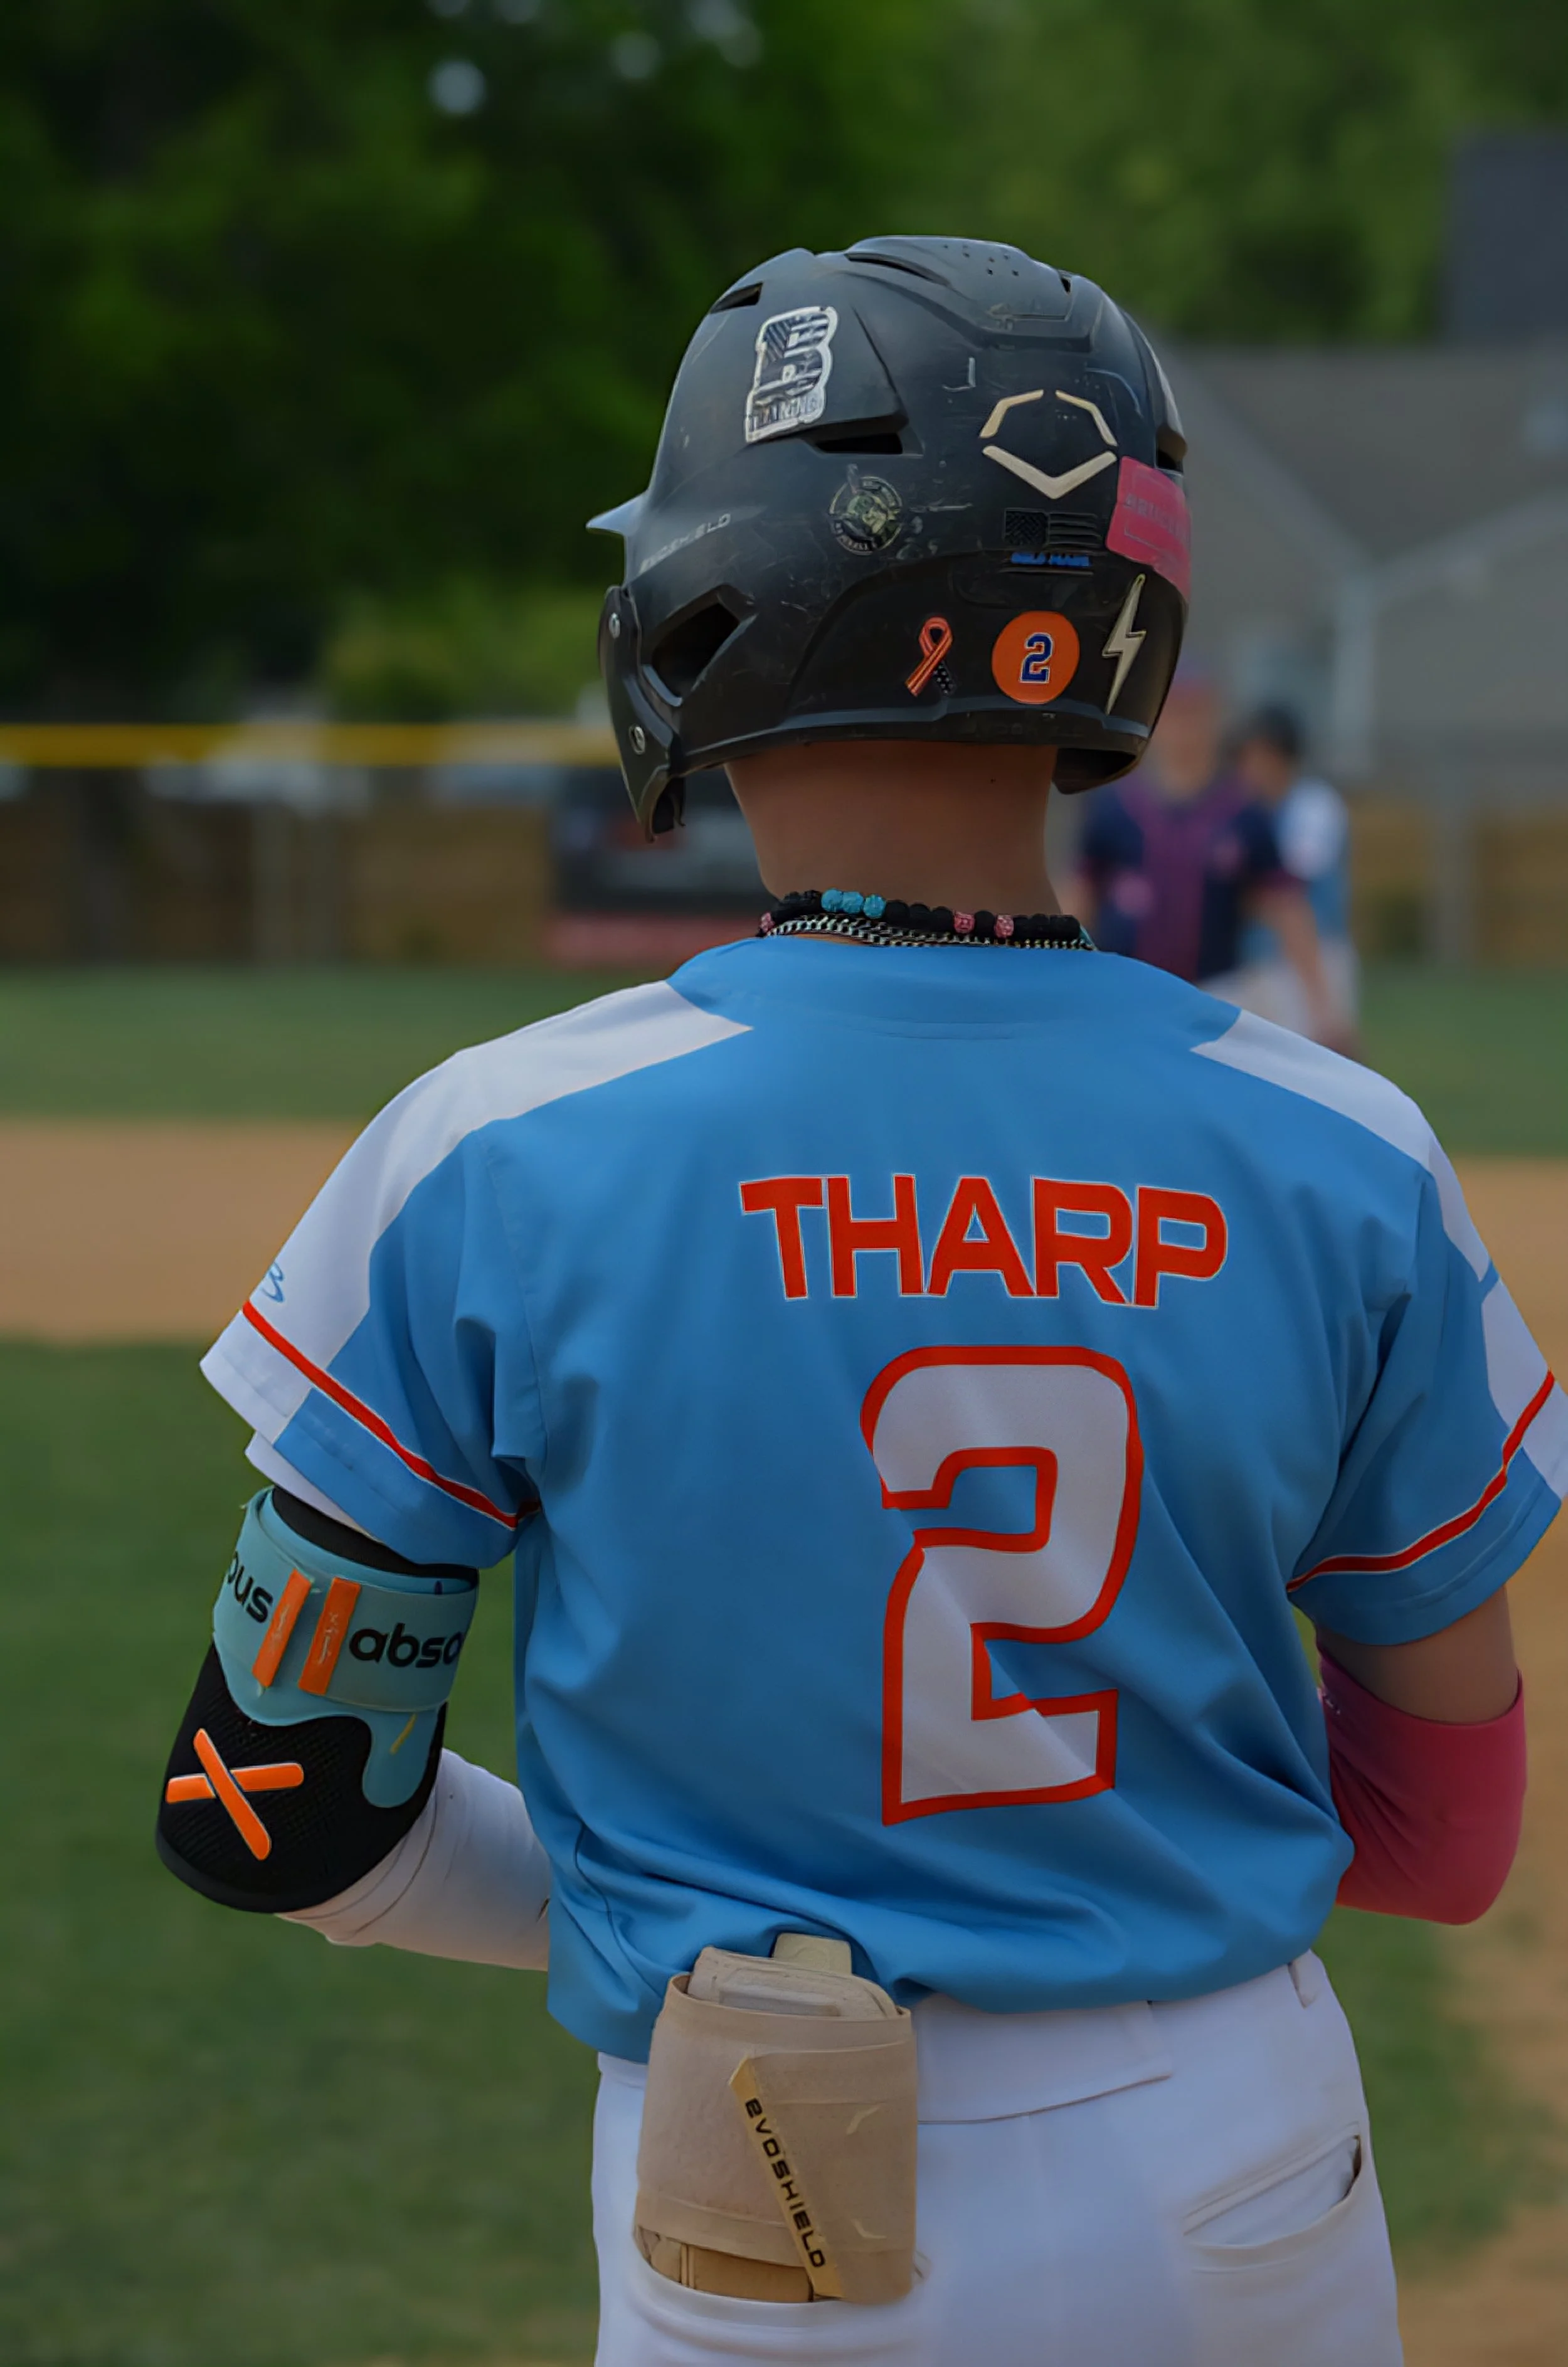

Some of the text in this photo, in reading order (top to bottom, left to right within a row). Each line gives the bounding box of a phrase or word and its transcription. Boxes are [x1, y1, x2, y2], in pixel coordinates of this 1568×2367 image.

[1018, 632, 1054, 684] 2
[739, 1173, 1228, 1310] THARP
[860, 1345, 1144, 1826] 2
[744, 2097, 826, 2268] EVOSHIELD
